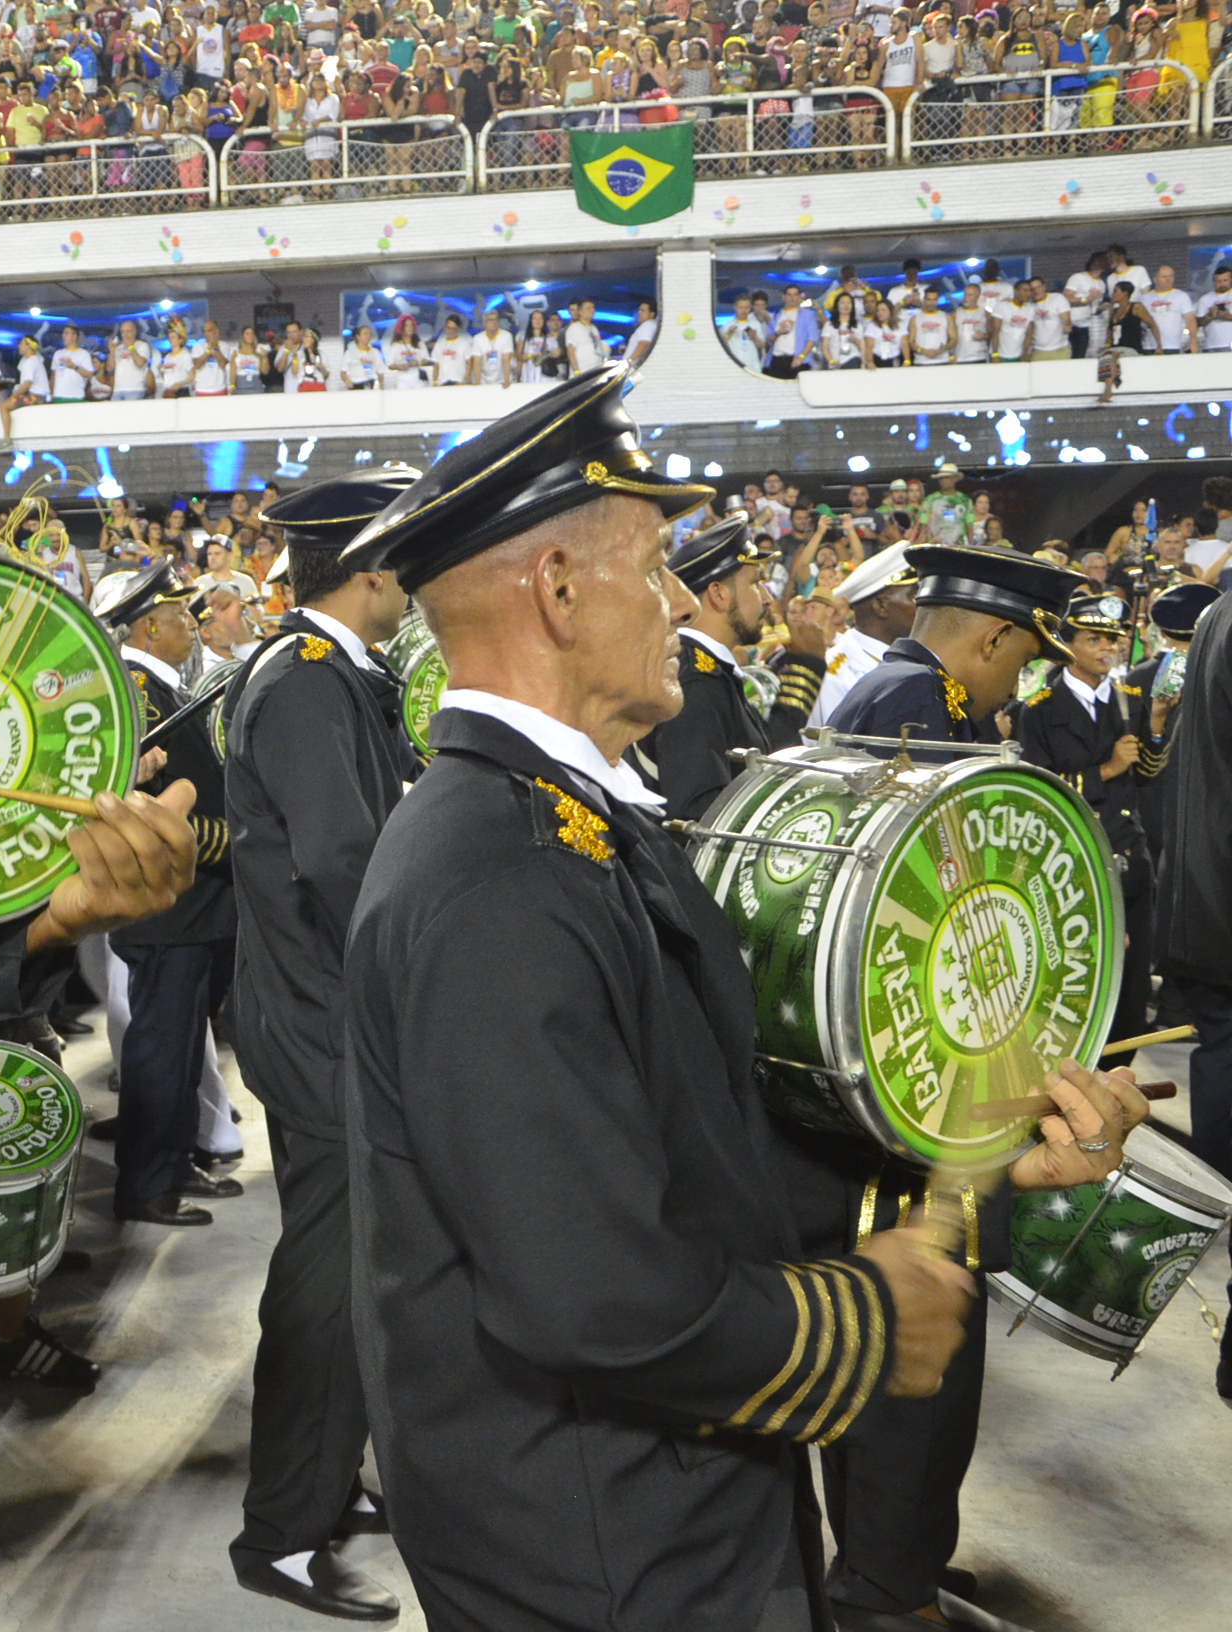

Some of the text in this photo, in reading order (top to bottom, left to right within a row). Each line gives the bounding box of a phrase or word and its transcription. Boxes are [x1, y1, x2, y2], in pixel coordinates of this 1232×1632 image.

[416, 661, 441, 726] BATERIA
[962, 802, 1091, 1072] RITMO FOLGADO
[1018, 915, 1029, 936] DO
[1042, 925, 1061, 969] 100%
[876, 928, 942, 1113] BATERIA
[21, 1086, 64, 1157] FOLGADO
